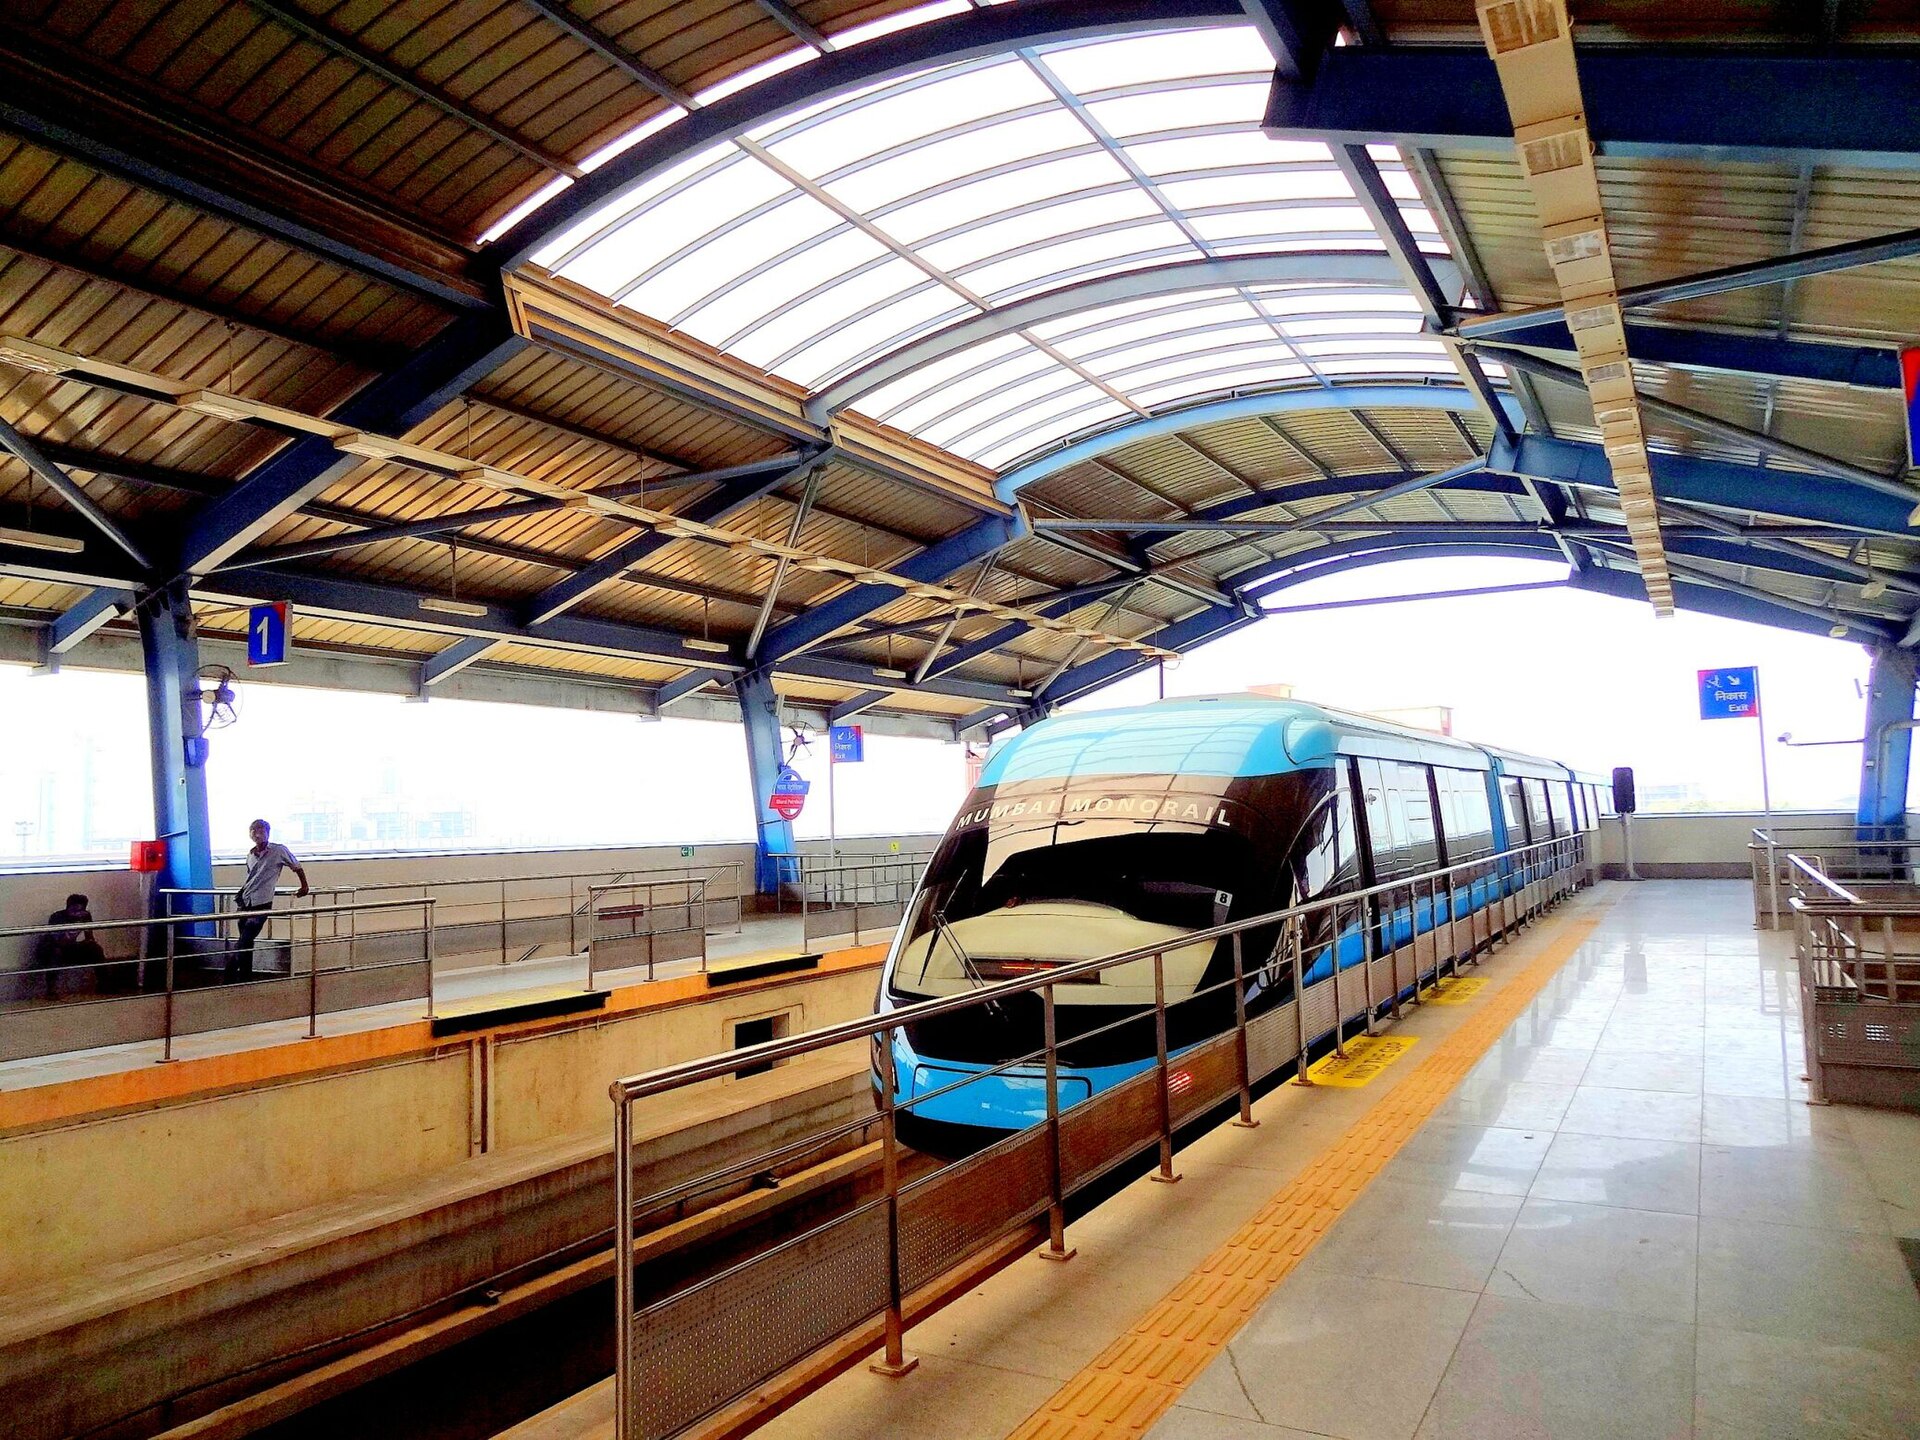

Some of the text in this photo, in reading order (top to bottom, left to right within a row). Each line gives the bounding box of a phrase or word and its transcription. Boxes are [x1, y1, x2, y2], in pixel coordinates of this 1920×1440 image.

[256, 616, 269, 655] 1
[1714, 690, 1748, 702] निकास
[1728, 703, 1749, 712] Exit
[954, 797, 1232, 831] MUMBAI MONORAIL
[1219, 892, 1228, 904] 8
